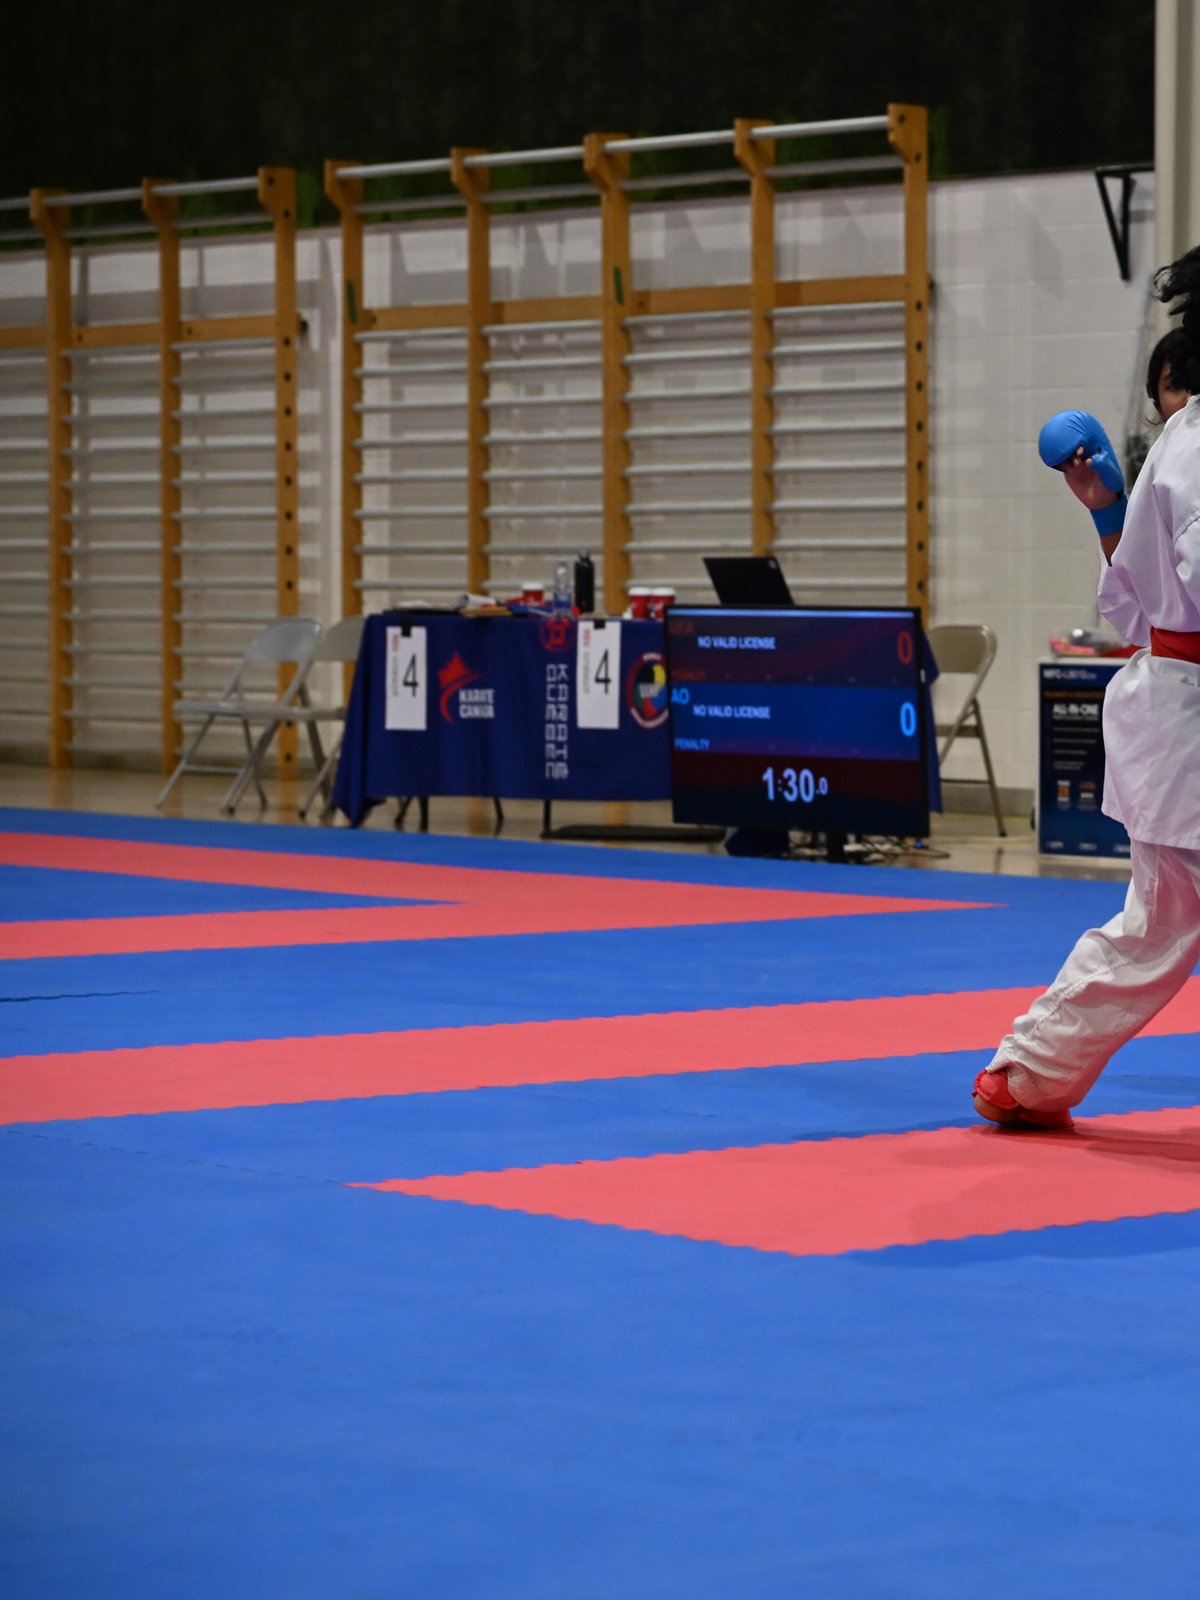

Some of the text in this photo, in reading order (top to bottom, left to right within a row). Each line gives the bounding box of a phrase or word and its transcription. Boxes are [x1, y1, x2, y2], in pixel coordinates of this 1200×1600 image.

[697, 636, 776, 650] NO VALID LICENSE
[897, 631, 913, 664] 0
[402, 653, 419, 697] 4
[594, 649, 611, 694] 4
[671, 688, 690, 704] AO
[693, 704, 771, 719] NO VALID LICENSE
[900, 702, 916, 737] 0
